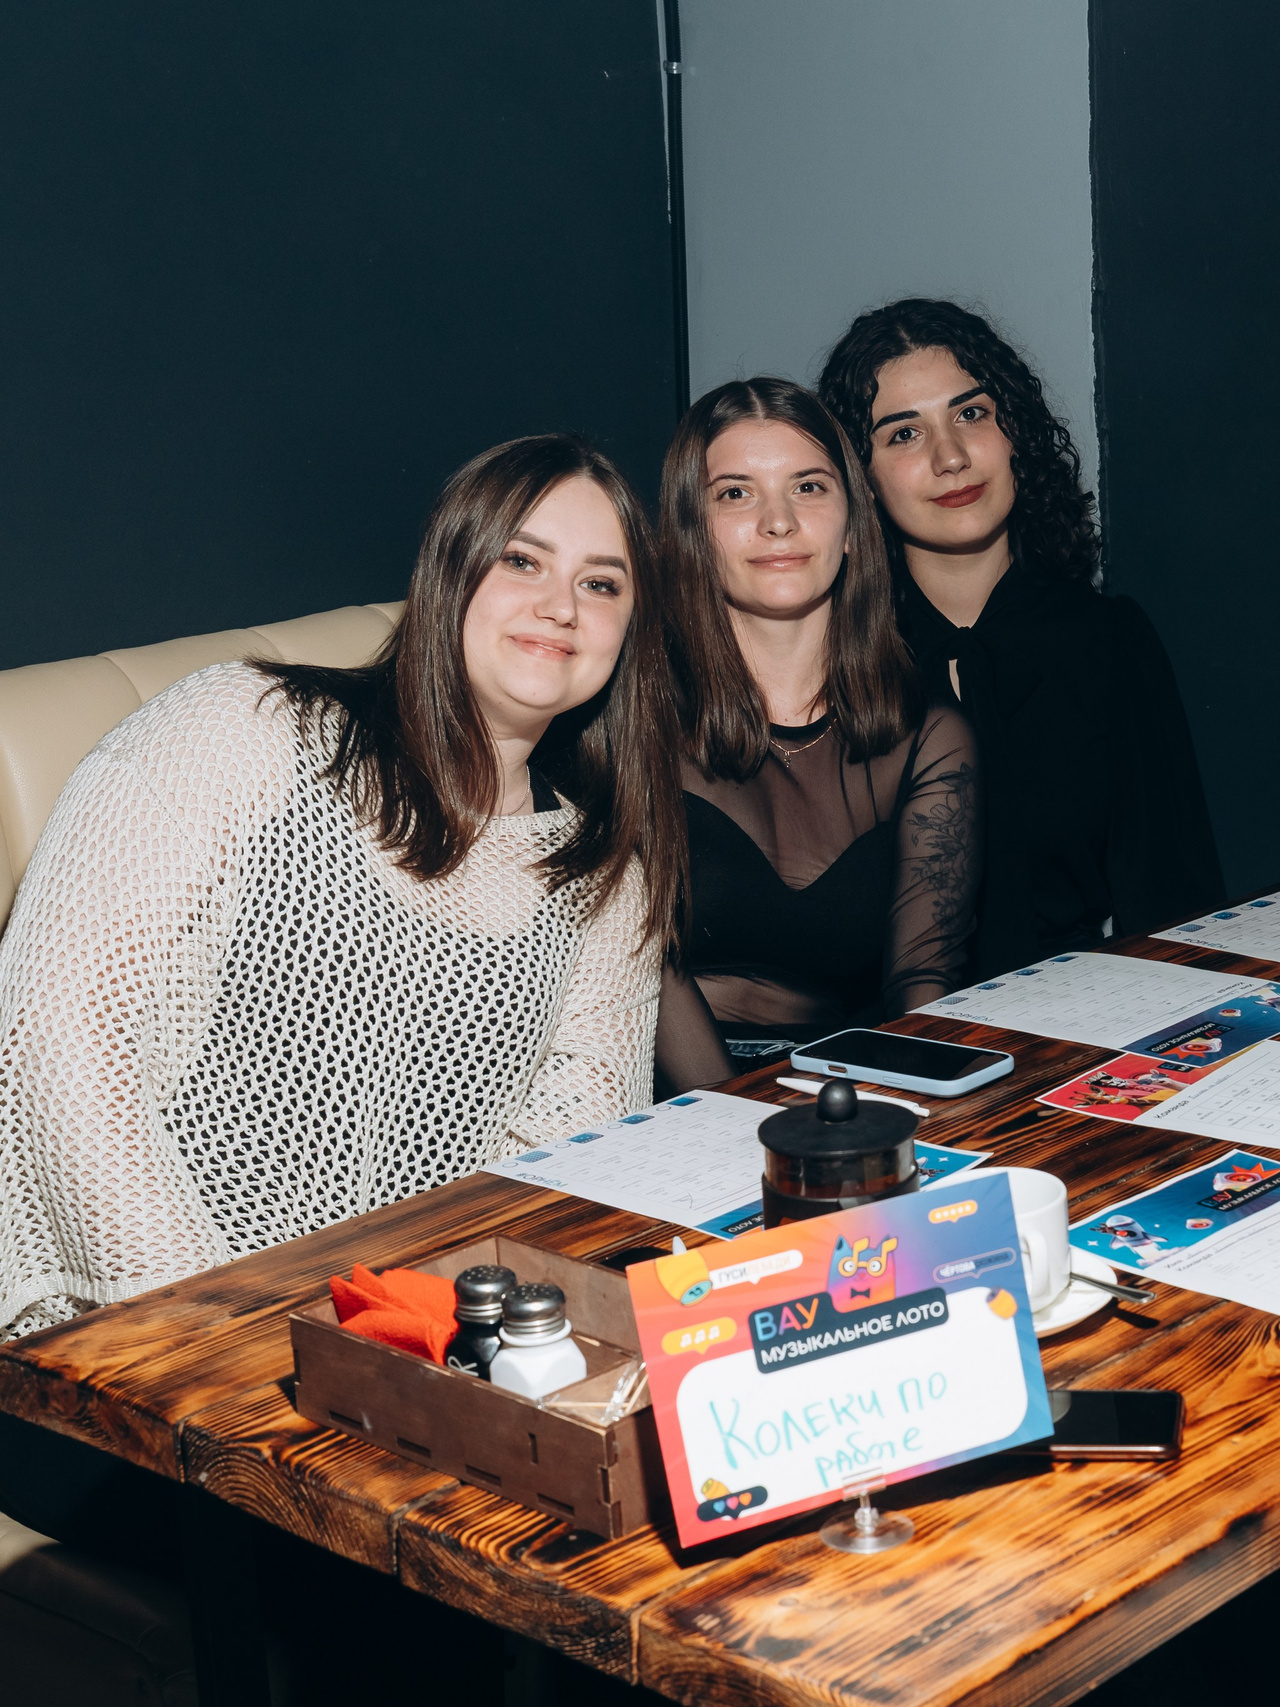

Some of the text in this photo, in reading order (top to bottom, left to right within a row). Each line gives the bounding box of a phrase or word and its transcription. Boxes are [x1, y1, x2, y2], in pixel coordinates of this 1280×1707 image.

[754, 1298, 819, 1342] ВАУ
[760, 1301, 945, 1365] МУЗЫКАЛЬНОЕ ЛОТО
